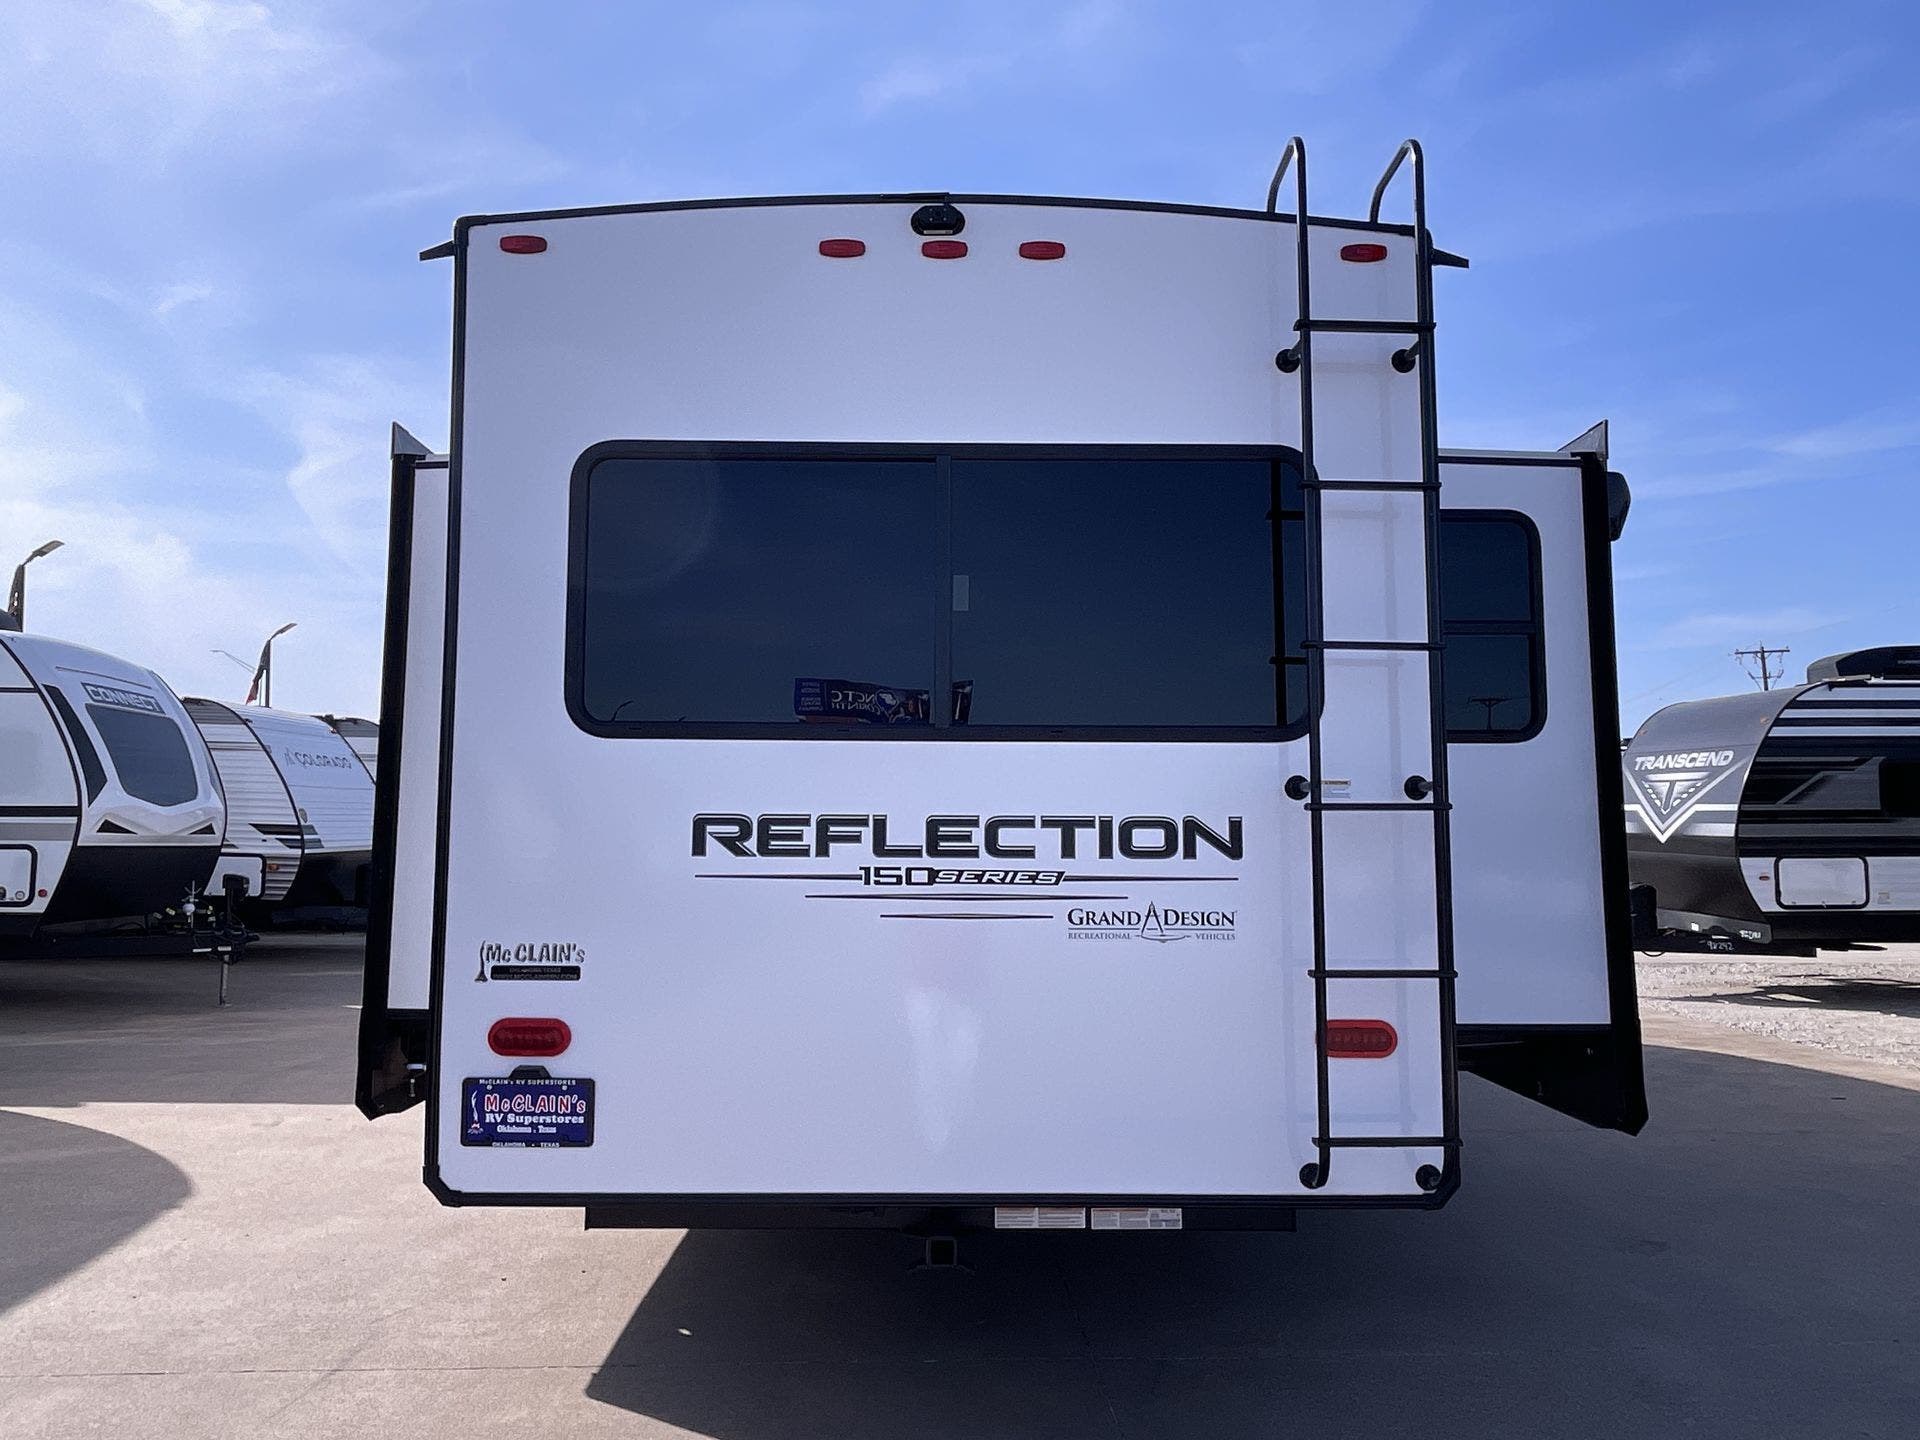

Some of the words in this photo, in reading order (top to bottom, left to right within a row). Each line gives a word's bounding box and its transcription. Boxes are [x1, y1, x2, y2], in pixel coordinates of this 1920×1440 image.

[86, 686, 161, 712] CONNECT
[294, 752, 352, 769] COLORADO
[1635, 751, 1734, 771] TRANSCEND
[691, 813, 1244, 861] REFLECTION
[859, 866, 934, 885] 150
[934, 870, 1059, 885] SERIES
[1067, 908, 1141, 926] GRAND
[1163, 909, 1235, 927] DESIGN
[1195, 933, 1236, 941] VEHICLES
[485, 1113, 504, 1123] RV
[507, 1113, 585, 1125] Superstores
